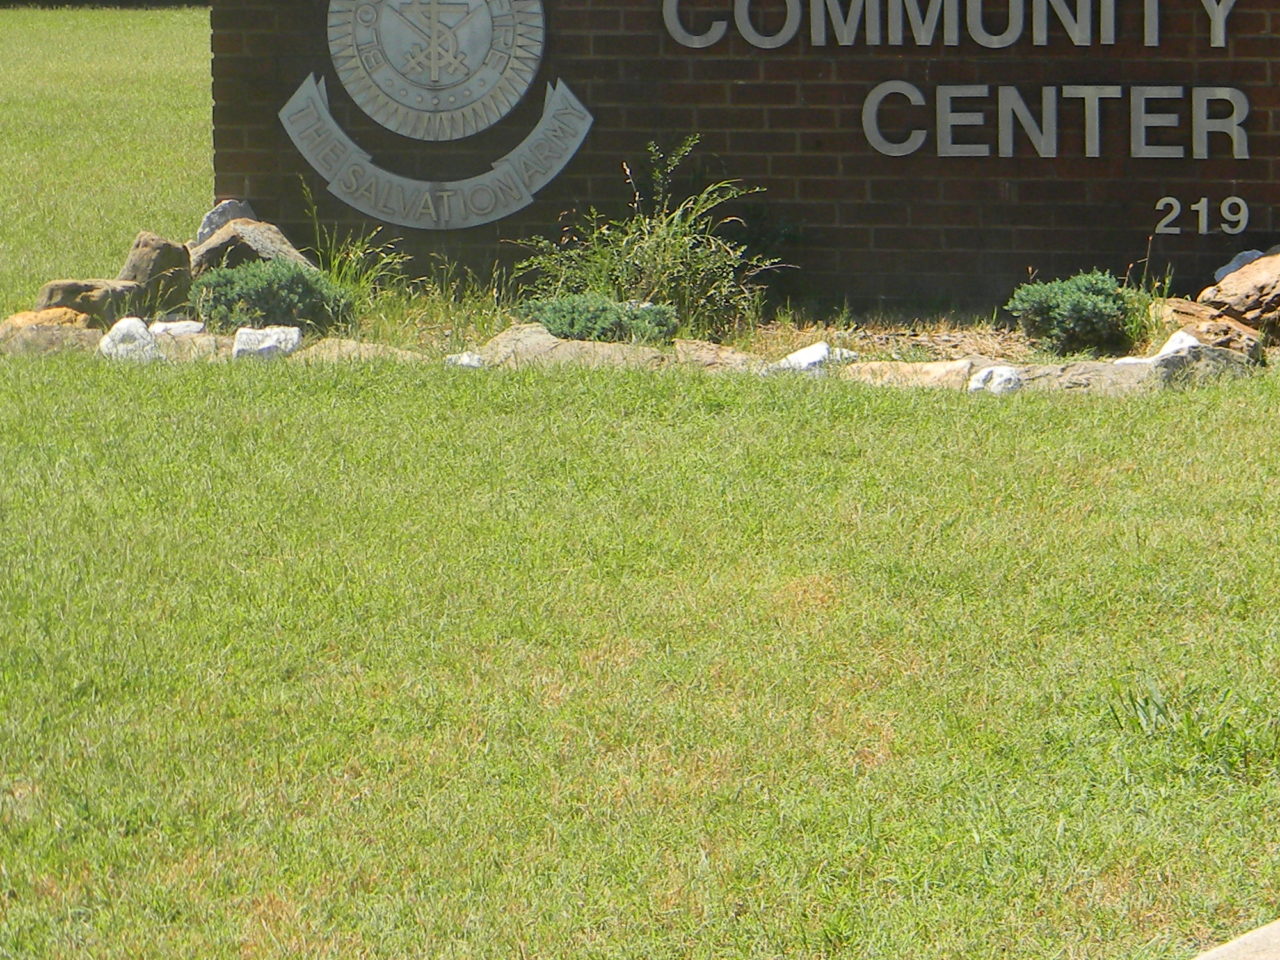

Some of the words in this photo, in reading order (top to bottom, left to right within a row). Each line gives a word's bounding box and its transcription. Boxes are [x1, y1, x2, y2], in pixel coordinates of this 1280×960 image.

[861, 79, 1250, 160] CENTER
[287, 97, 346, 172] THE
[338, 163, 523, 224] SALVATION
[521, 101, 589, 186] ARMY
[1155, 196, 1250, 236] 219
